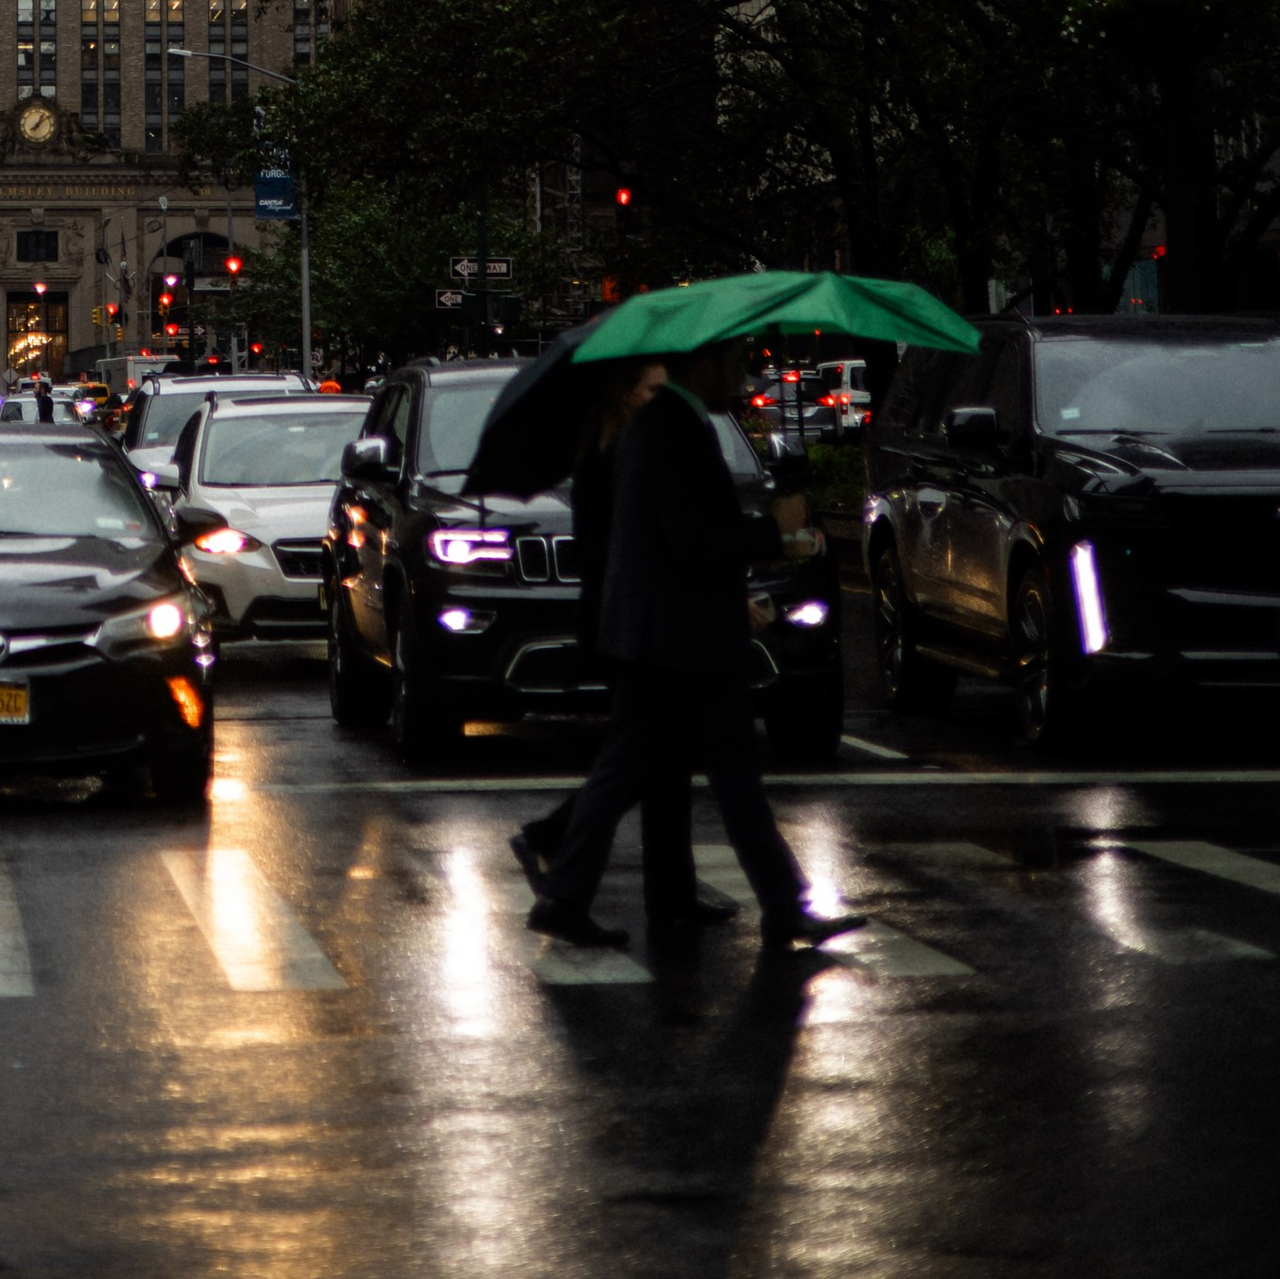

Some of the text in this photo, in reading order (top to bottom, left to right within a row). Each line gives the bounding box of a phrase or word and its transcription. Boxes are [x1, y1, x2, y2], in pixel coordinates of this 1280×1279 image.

[460, 264, 504, 273] ONE WAY
[444, 294, 458, 302] ONE
